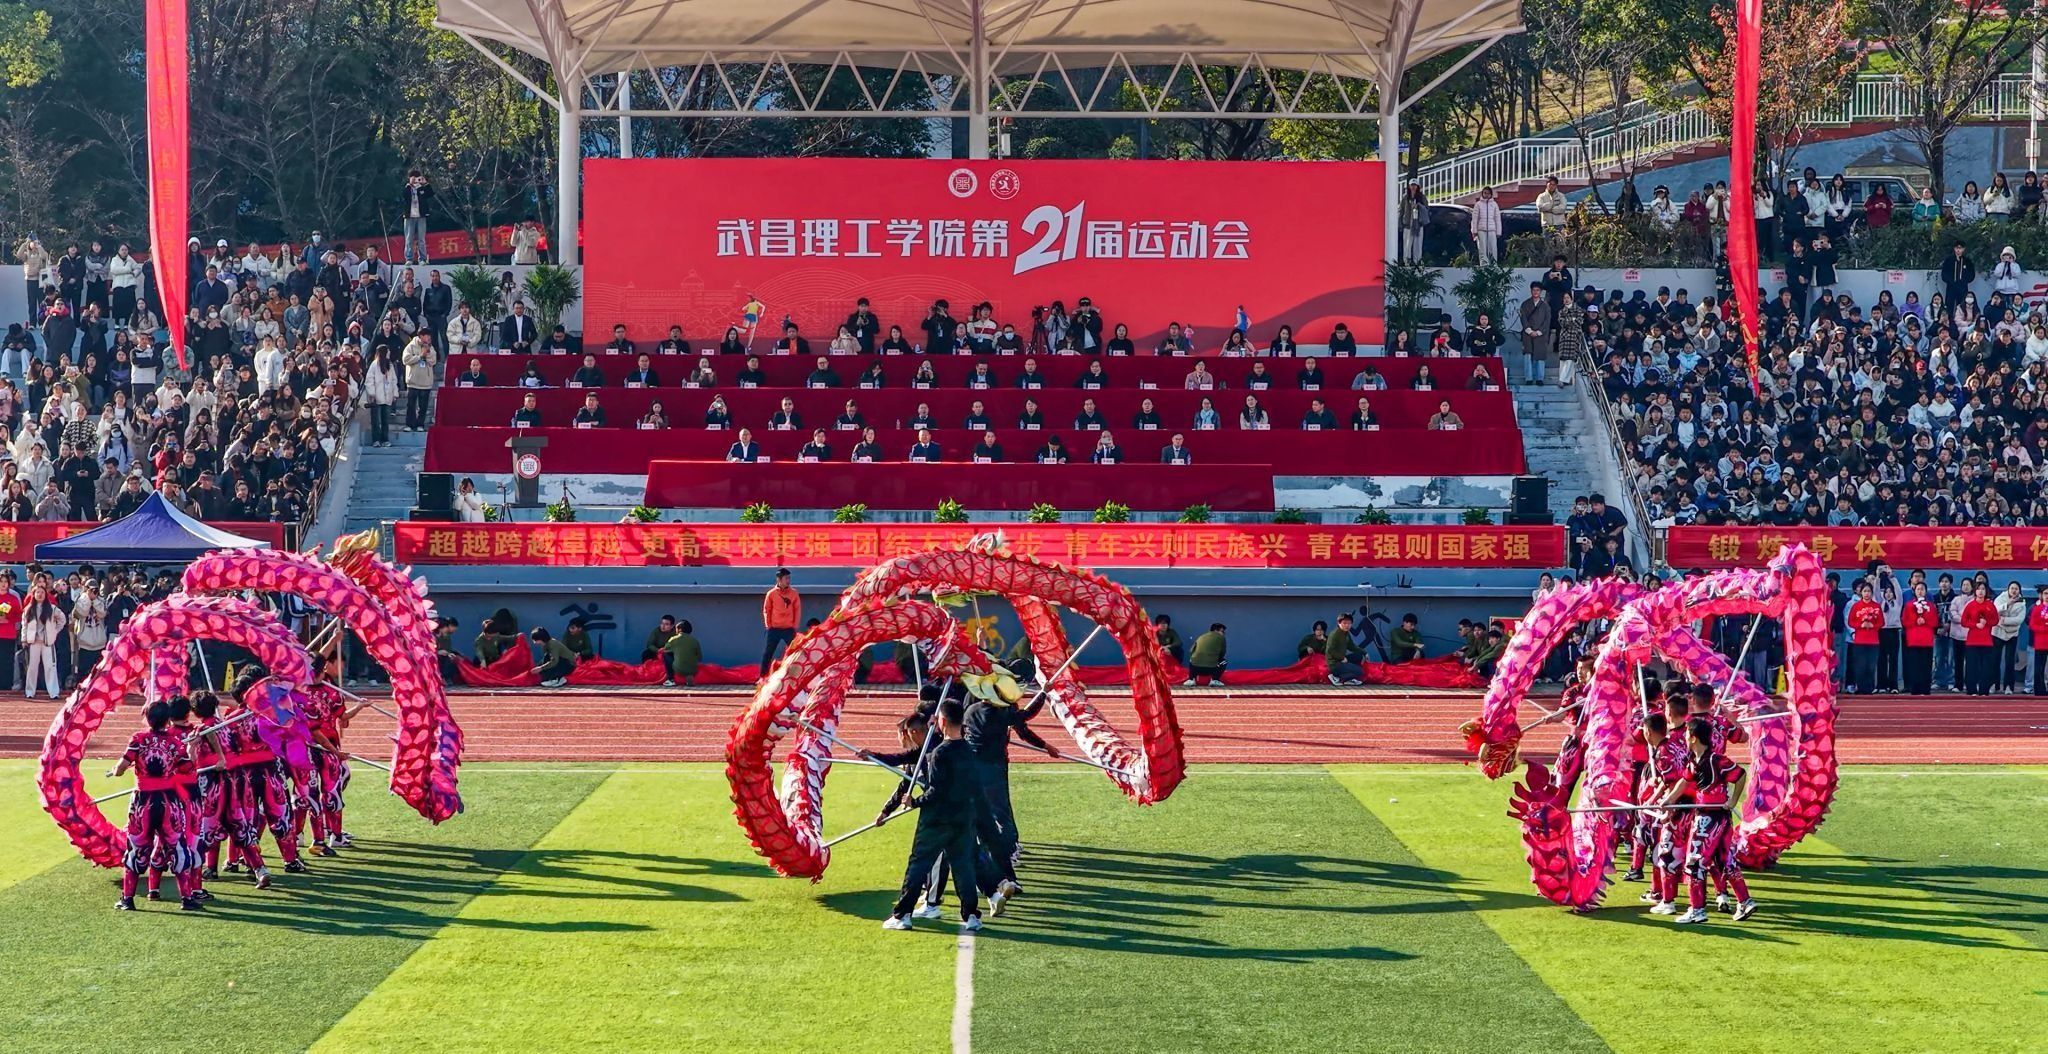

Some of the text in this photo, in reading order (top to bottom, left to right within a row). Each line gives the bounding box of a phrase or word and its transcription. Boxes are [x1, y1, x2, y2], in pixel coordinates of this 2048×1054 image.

[716, 199, 1250, 276] 武昌理工学院第21届运动会
[429, 530, 1531, 560] 超越跨越卓越 更高更快更强 团结友谊步 青年兴则民族兴 青年强则国家强
[1708, 534, 1887, 561] 锻炼身体
